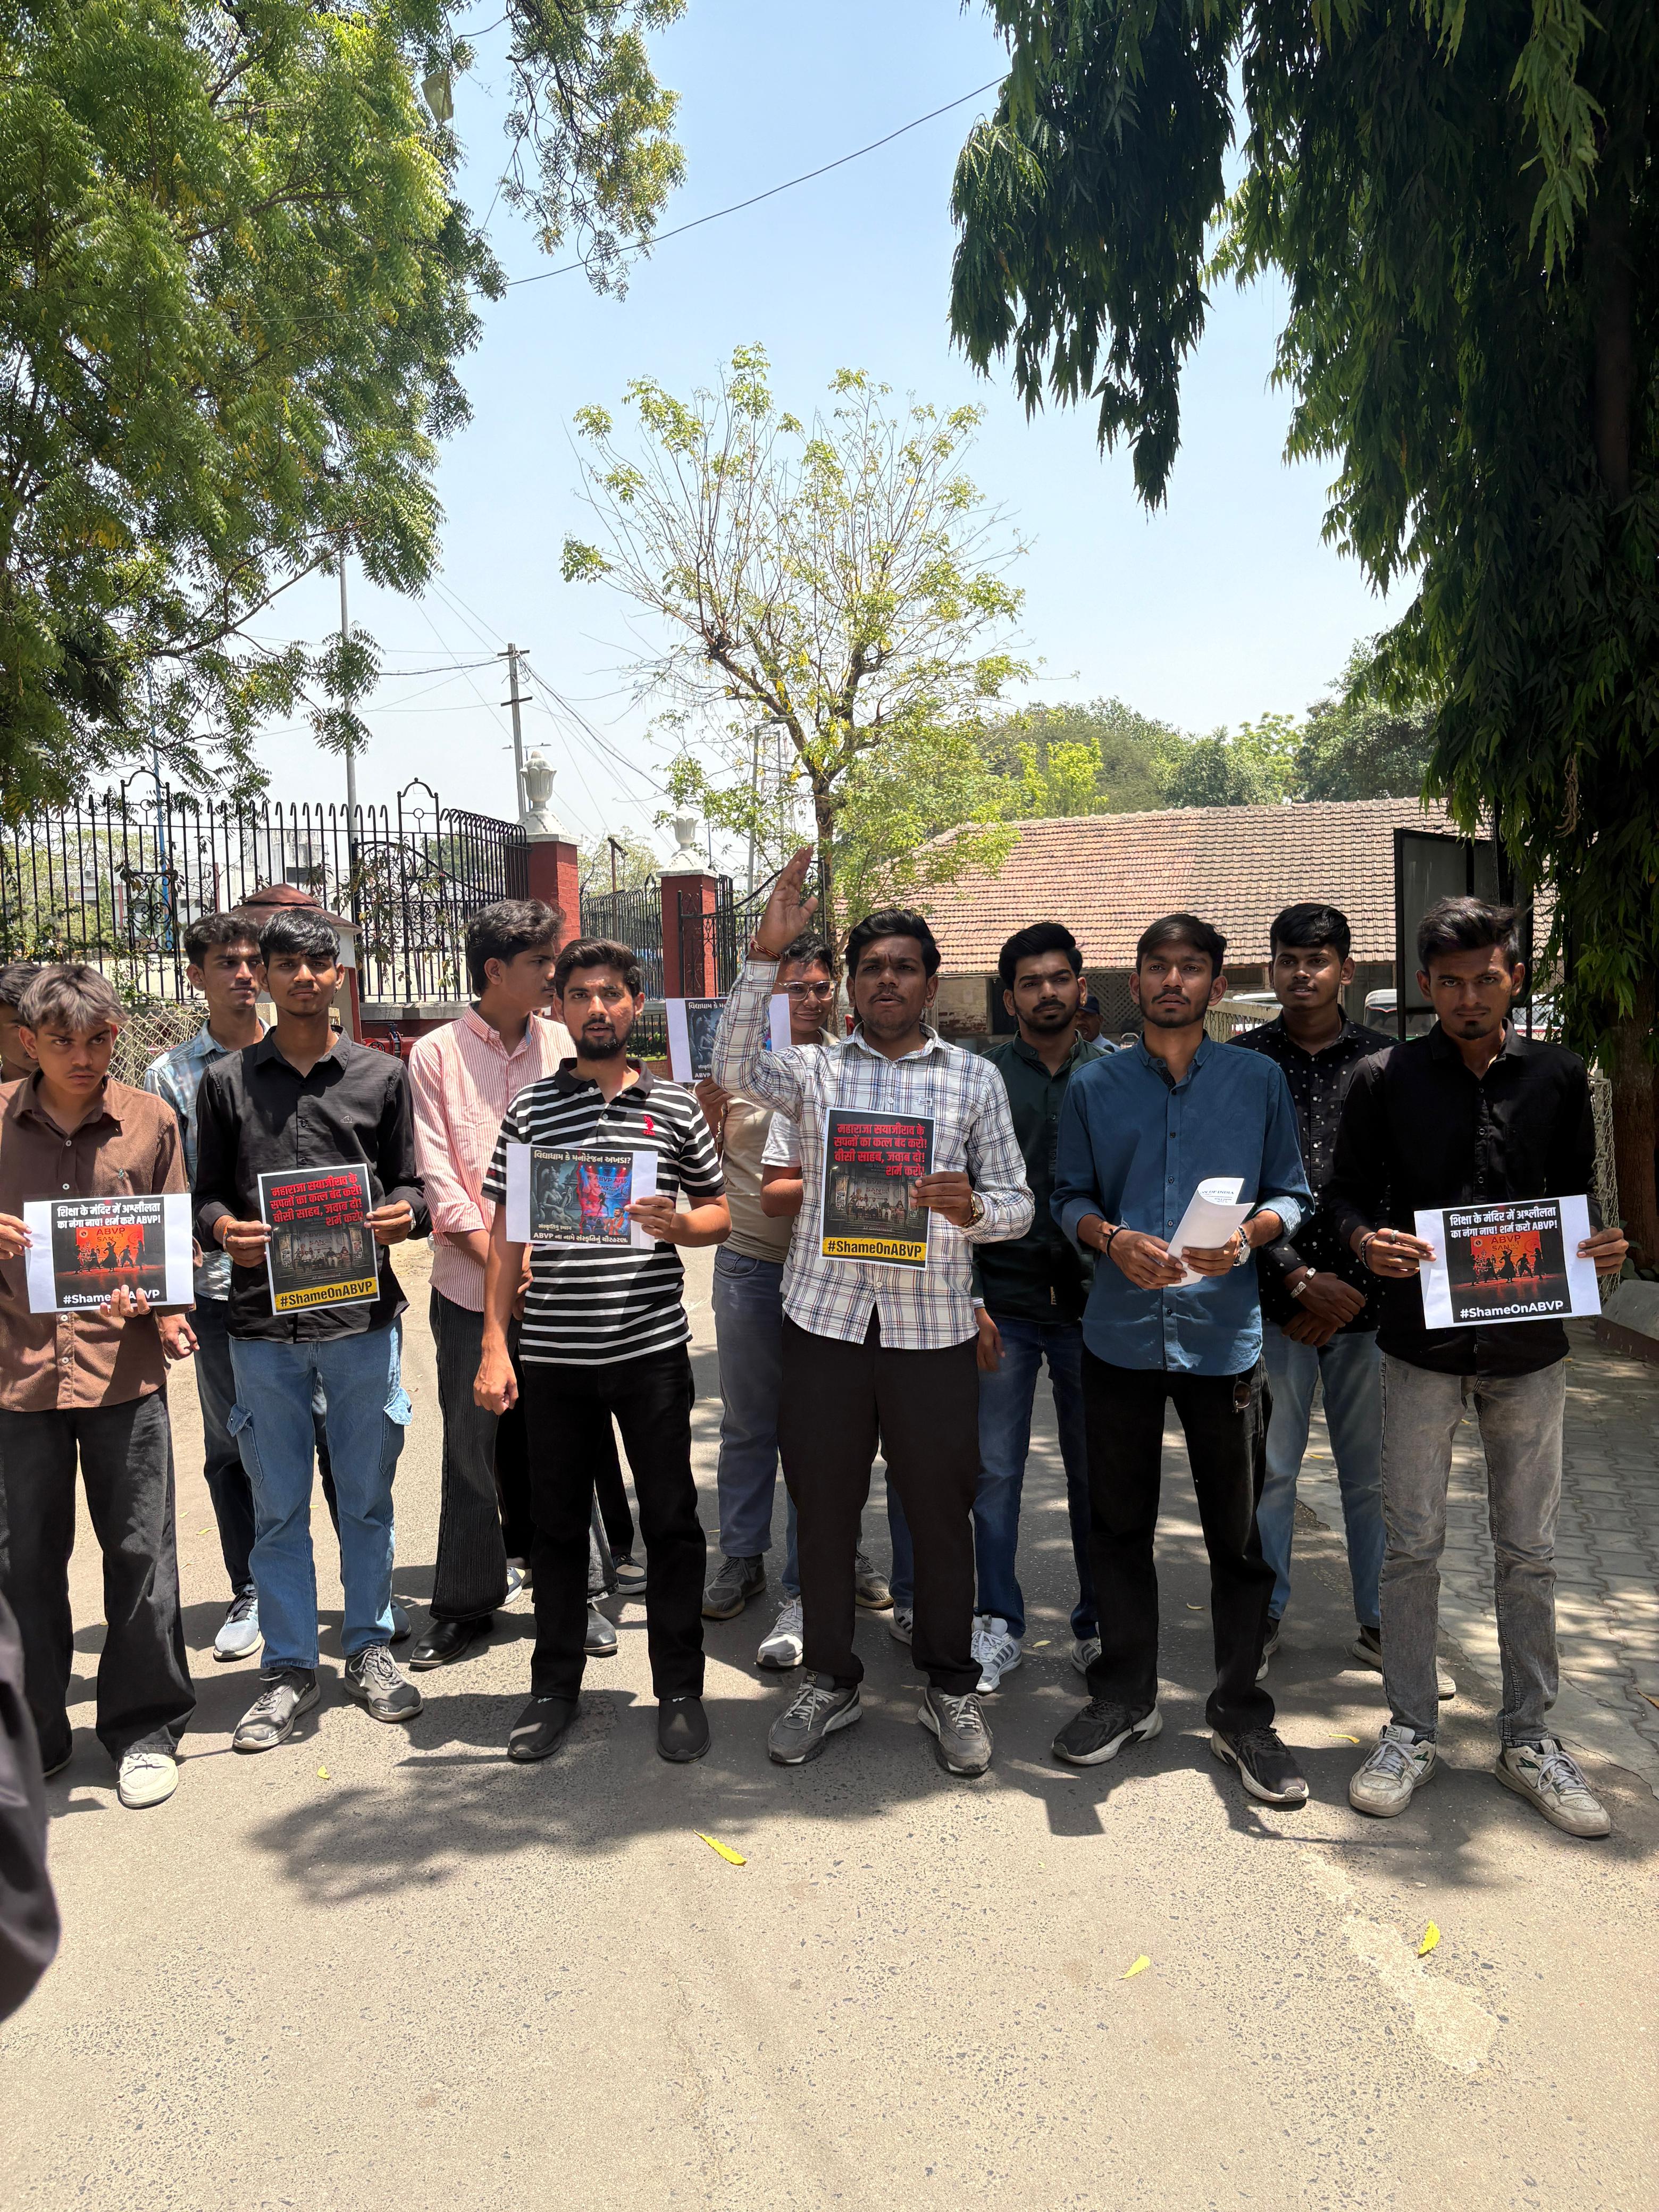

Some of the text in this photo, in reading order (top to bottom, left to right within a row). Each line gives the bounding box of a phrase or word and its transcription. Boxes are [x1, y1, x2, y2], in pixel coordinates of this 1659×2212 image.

[837, 1122, 925, 1136] महाराजा सयाजीराव के
[833, 1134, 859, 1147] सपनों
[860, 1137, 871, 1147] का
[873, 1137, 893, 1149] कत्ल
[907, 1137, 927, 1149] करो!
[565, 1151, 571, 1161] કે
[572, 1153, 602, 1163] મનોરંજન
[834, 1149, 925, 1164] वीसी साहब, जवाब दो!
[885, 1164, 902, 1177] शर्म
[271, 1172, 358, 1196] महाराजा सयाजीराव के
[270, 1185, 362, 1210] सपनों का कत्ल बंद करो!
[57, 1201, 161, 1218] शिक्षा के मंदिर में अश्लीलता
[272, 1209, 295, 1224] वीसी
[296, 1206, 323, 1219] साहब,
[324, 1201, 348, 1215] जवाब
[1449, 1206, 1556, 1227] शिक्षा के मंदिर में अश्लीलता
[57, 1214, 161, 1229] का नंगा नाच! शर्म करो ABVP!
[325, 1215, 342, 1227] शर्म
[96, 1227, 125, 1236] ABVP
[1451, 1220, 1557, 1238] का नंगा नाच! शर्म करो ABVP!
[1491, 1235, 1521, 1244] ABVP
[827, 1241, 921, 1258] #ShameOnABVP
[63, 1289, 160, 1304] #ShameAVP
[280, 1280, 372, 1306] #ShameOnABVP
[1460, 1300, 1563, 1319] #ShameOnABVP
